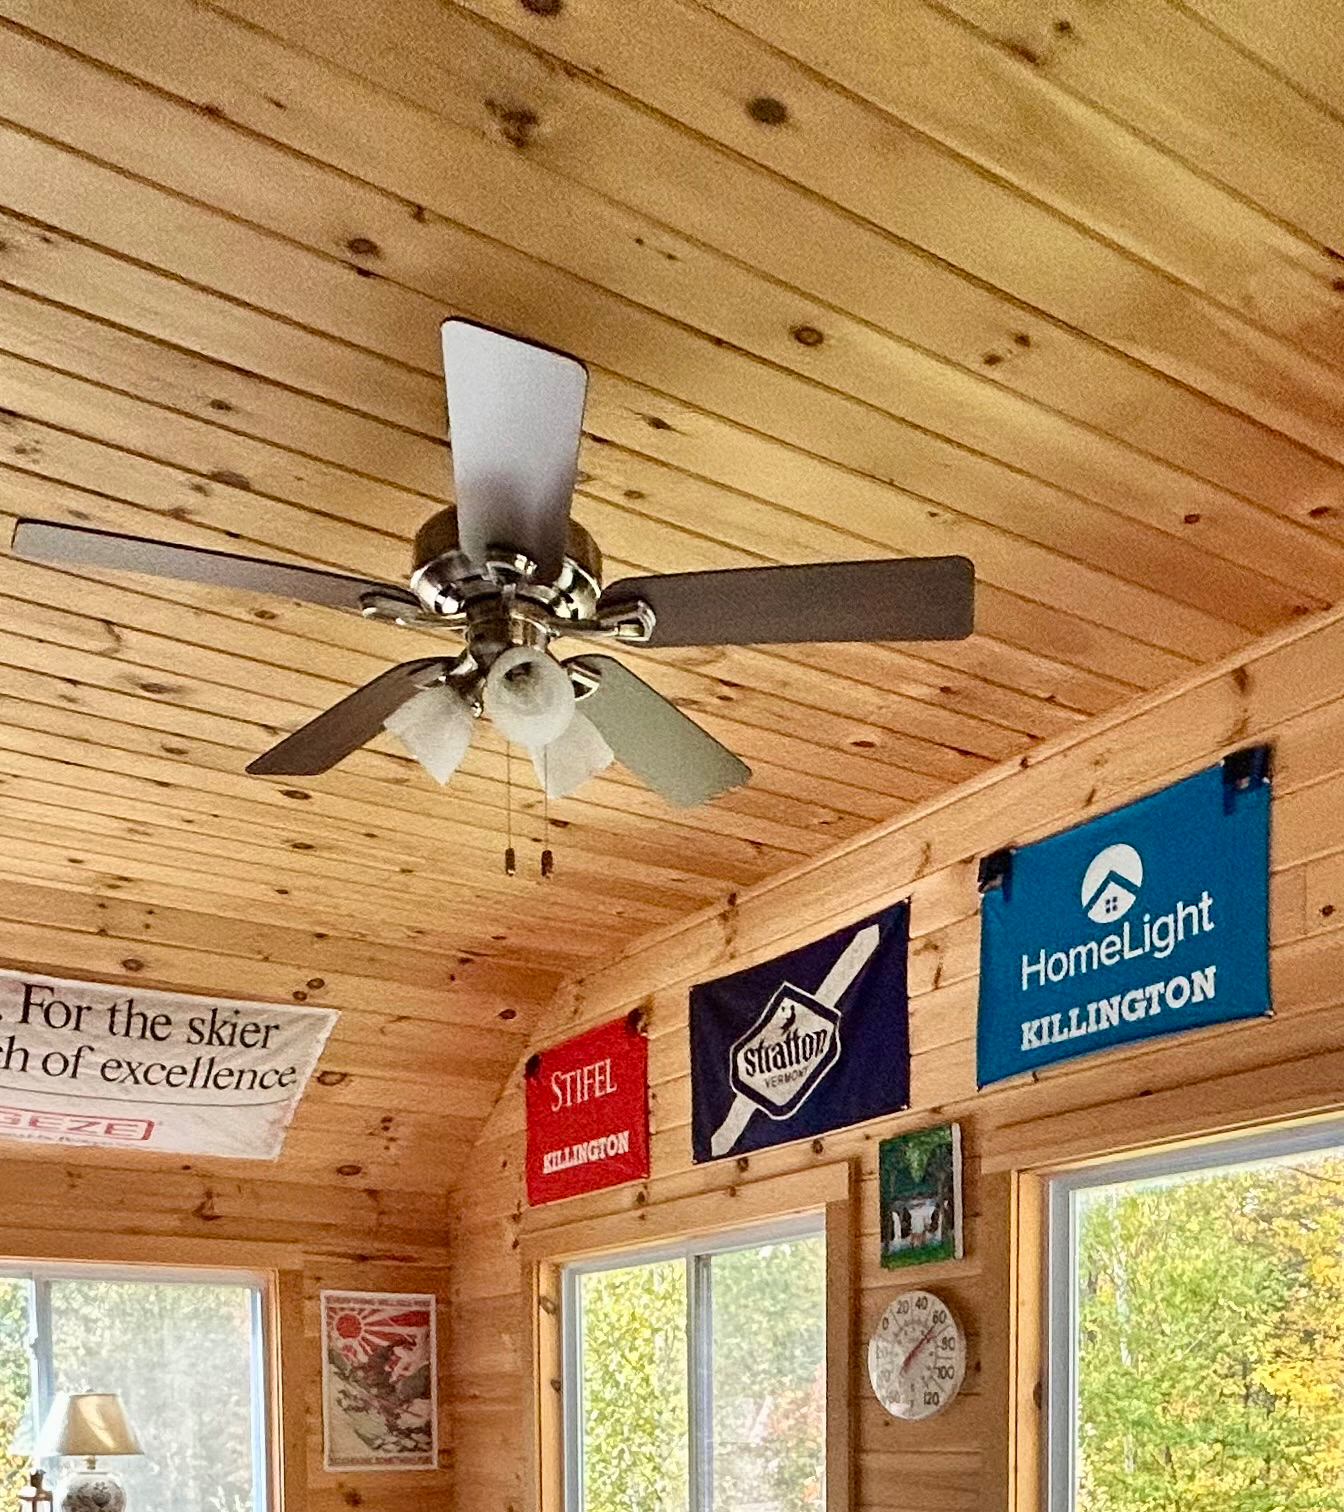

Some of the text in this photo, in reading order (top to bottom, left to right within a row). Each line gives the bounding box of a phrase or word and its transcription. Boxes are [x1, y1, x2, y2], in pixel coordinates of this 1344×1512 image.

[1022, 891, 1215, 990] HomeLight
[20, 984, 92, 1031] For
[109, 1000, 173, 1041] the
[187, 1008, 280, 1050] skier
[1021, 965, 1216, 1051] KILLINGTON
[42, 1045, 92, 1079] of
[100, 1057, 298, 1091] excellence
[744, 1027, 828, 1077] stratton
[550, 1058, 617, 1112] STIFEL
[764, 1066, 809, 1088] VERMONT
[543, 1130, 629, 1174] KILLINGTON
[896, 1300, 909, 1314] 20
[915, 1296, 928, 1309] 40
[932, 1310, 947, 1324] 60
[882, 1318, 889, 1330] 0
[938, 1367, 954, 1379] 100
[924, 1392, 939, 1405] 120
